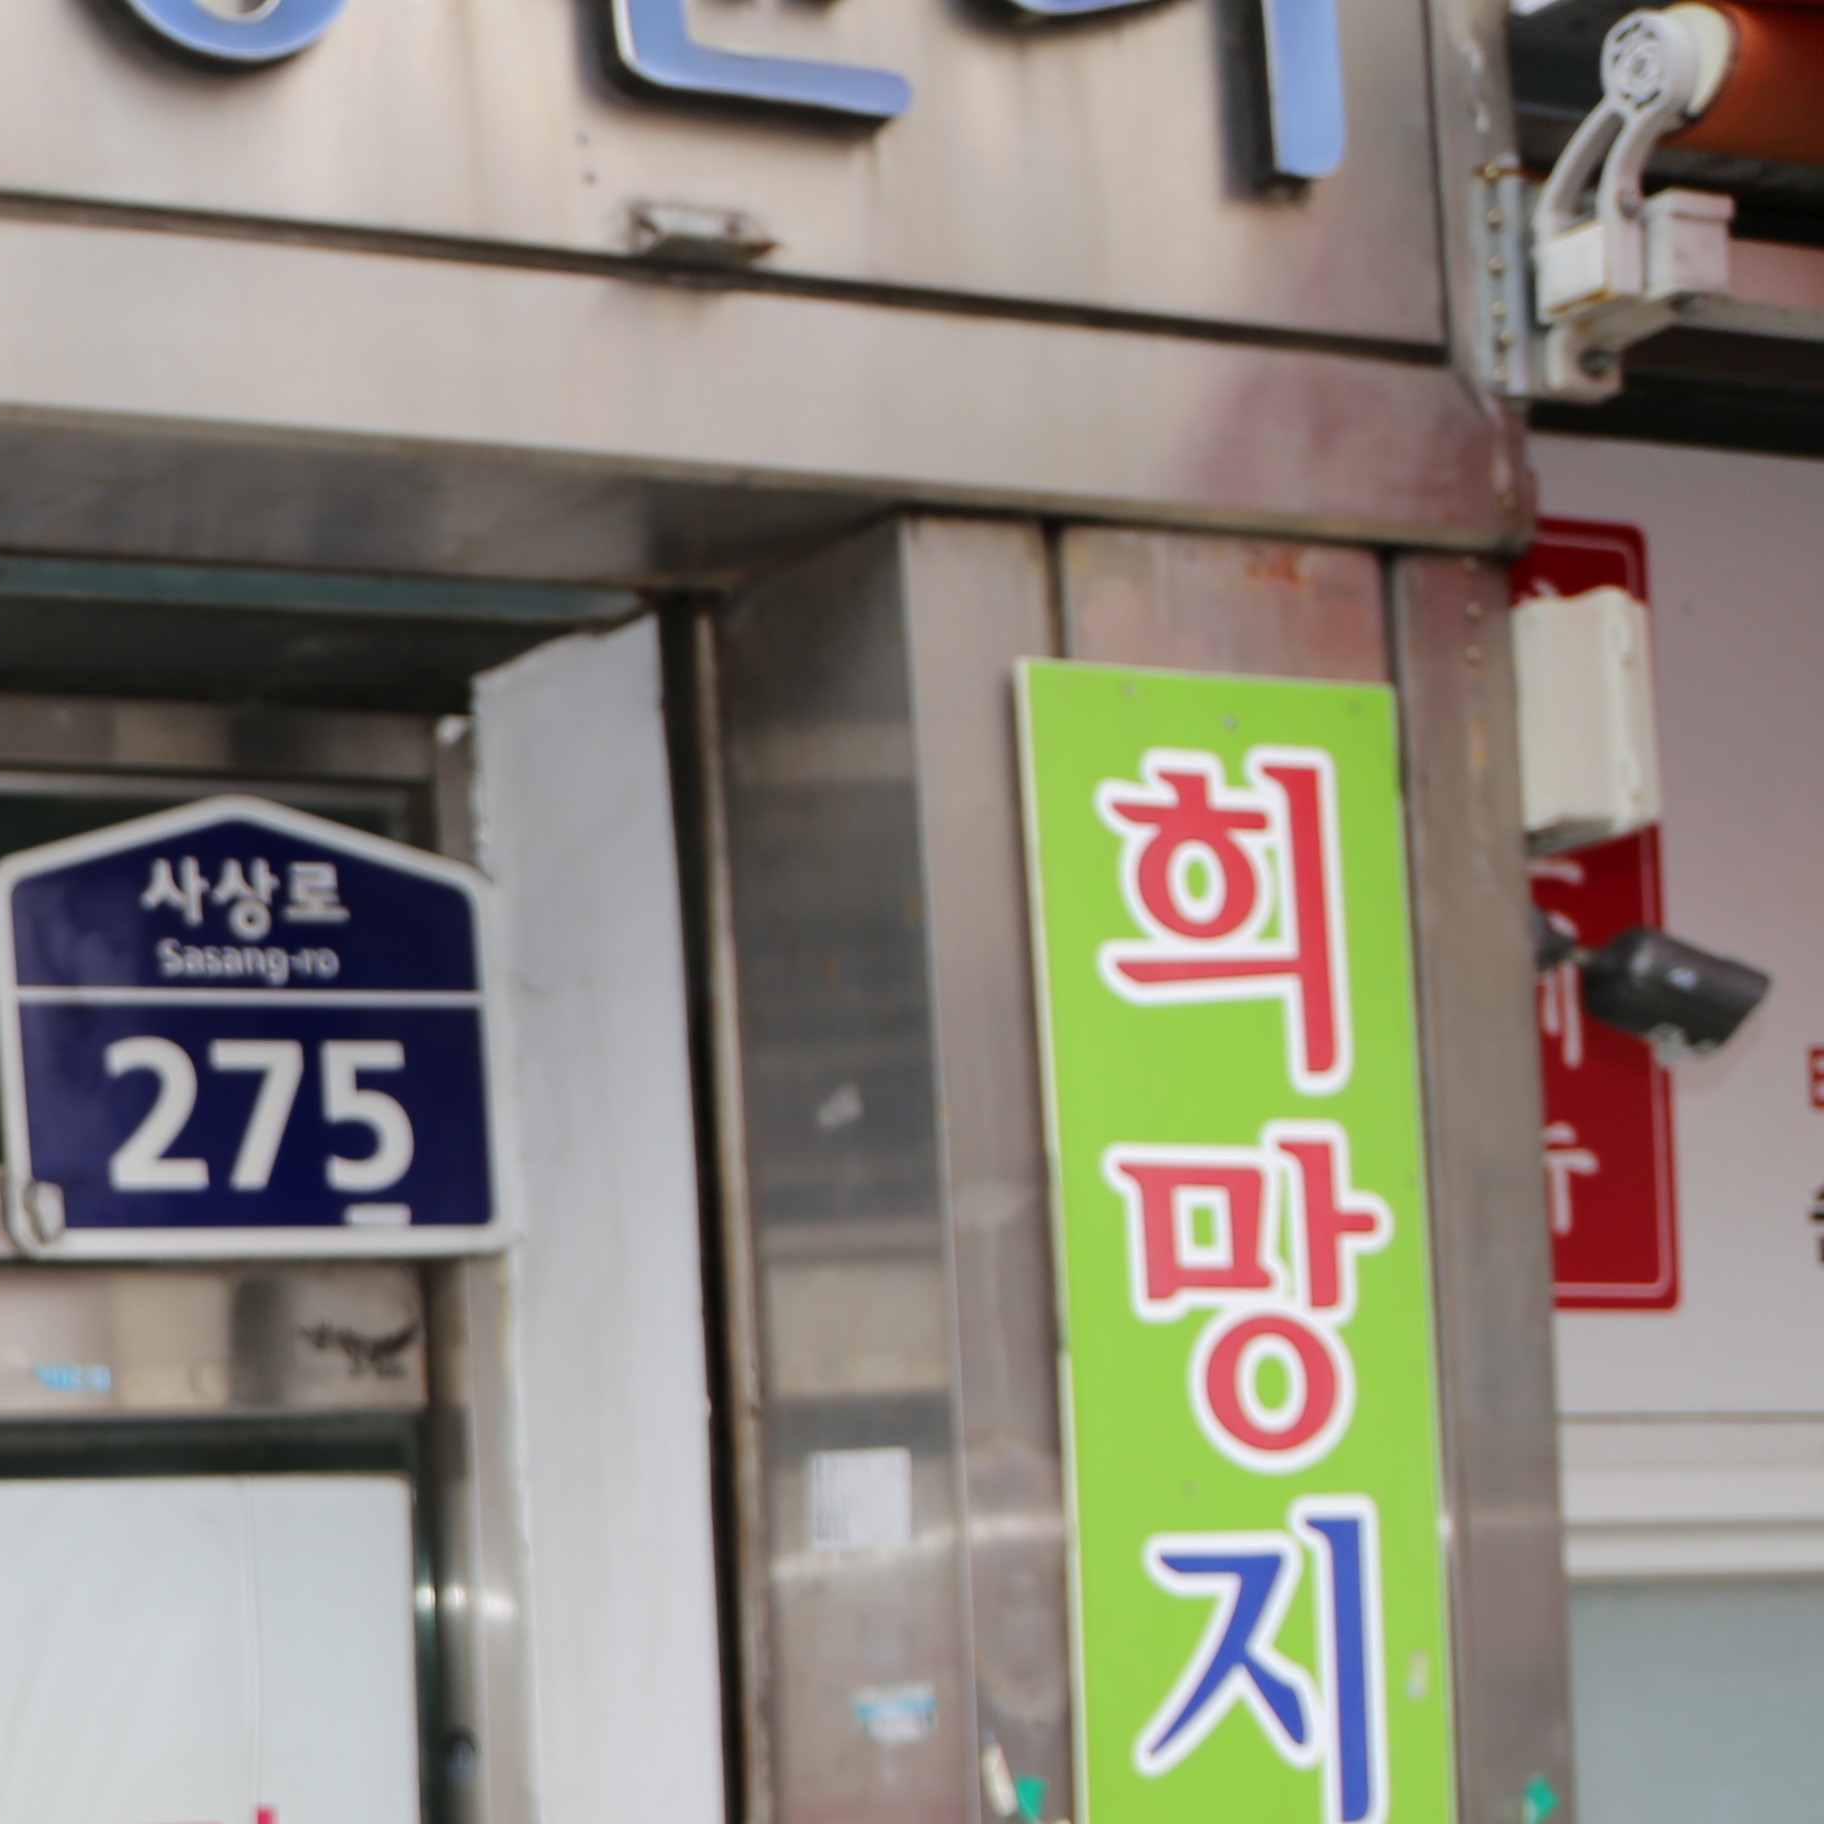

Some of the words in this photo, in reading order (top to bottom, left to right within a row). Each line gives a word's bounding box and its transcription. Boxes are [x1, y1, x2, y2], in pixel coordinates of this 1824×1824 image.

[142, 857, 350, 939] 사상로
[156, 936, 341, 985] Sasang-ro
[102, 1034, 416, 1194] 275
